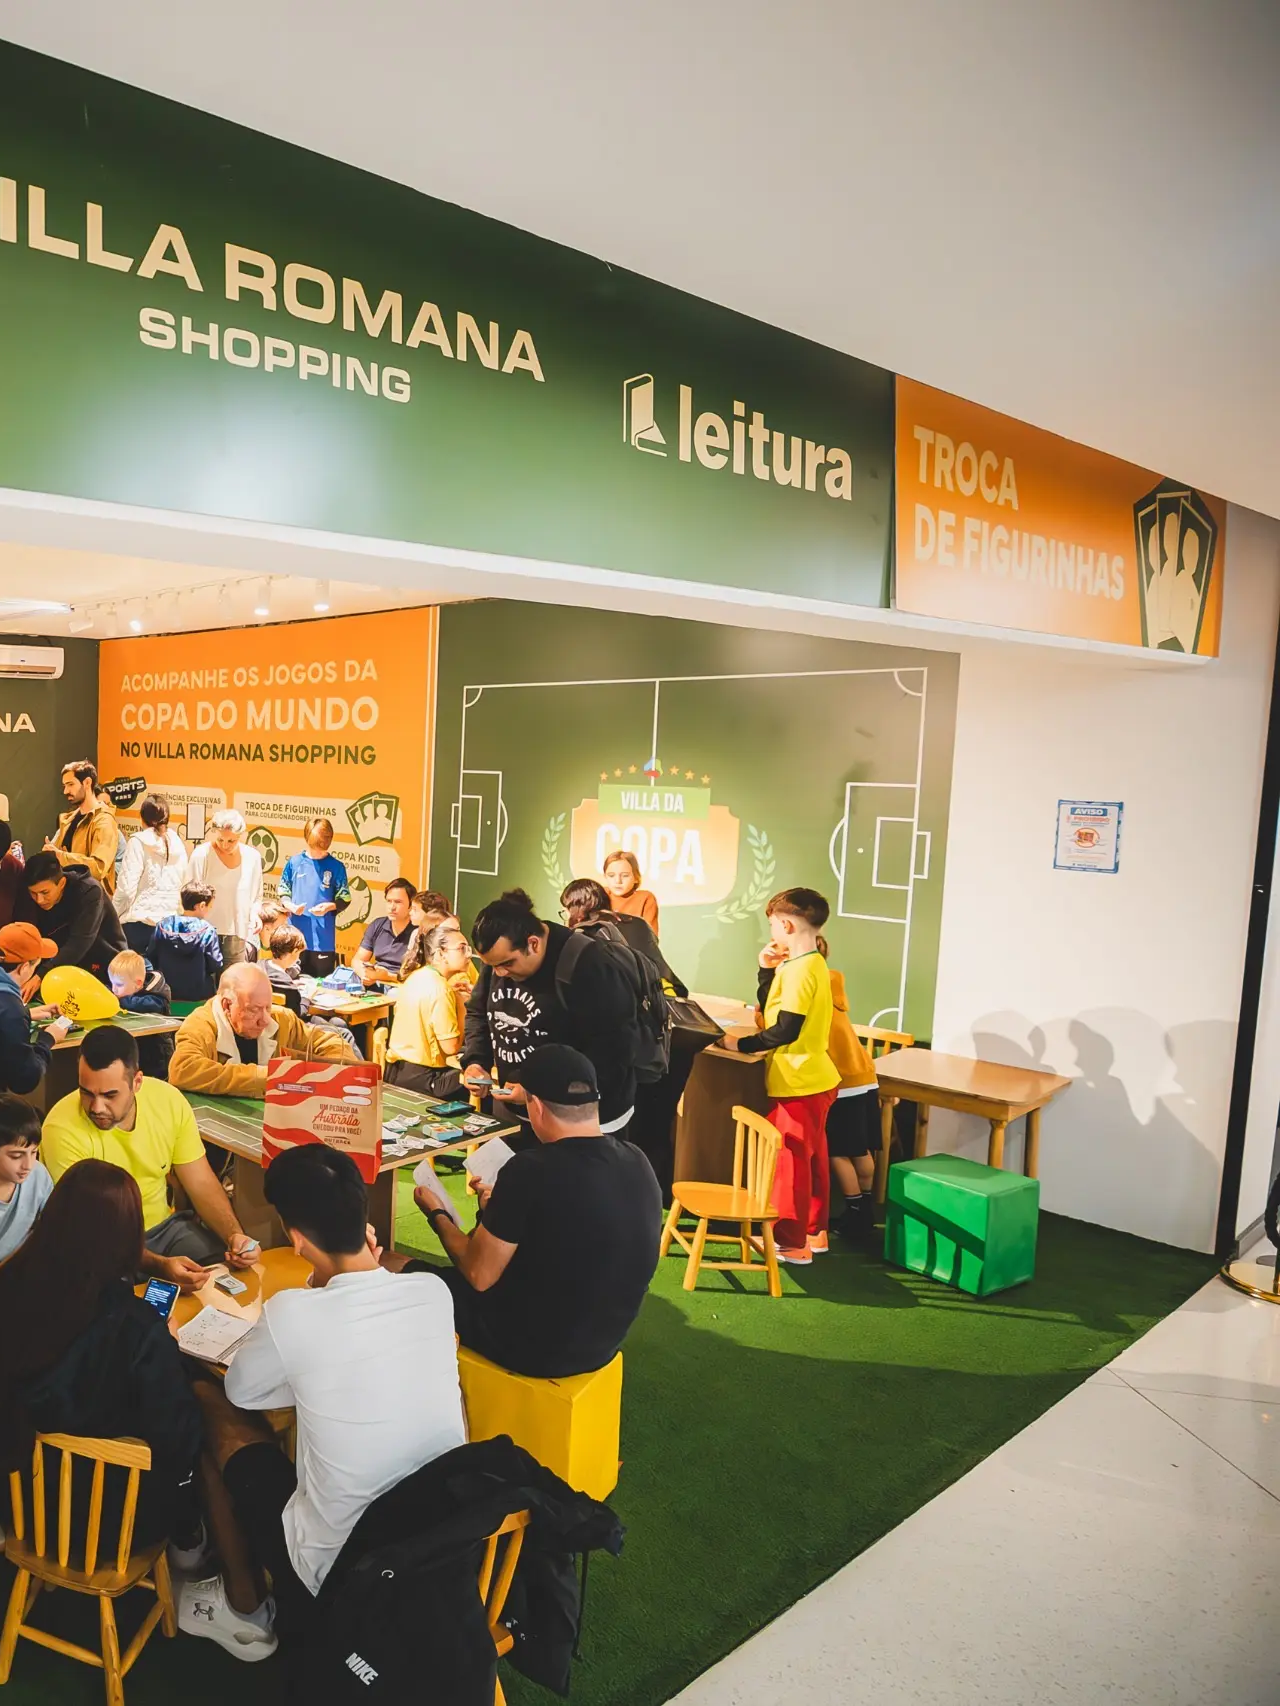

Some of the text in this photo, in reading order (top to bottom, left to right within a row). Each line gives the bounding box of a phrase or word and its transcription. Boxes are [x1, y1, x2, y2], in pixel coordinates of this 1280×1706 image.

[225, 242, 545, 382] ROMANA
[138, 307, 411, 403] SHOPPING
[678, 383, 853, 501] leitura
[913, 424, 1019, 511] TROCA
[914, 503, 1125, 601] DE FIGURINHAS
[120, 658, 378, 693] ACOMPANHE OS JOGOS DA
[120, 695, 379, 731] COPA DO MUNDO
[120, 741, 377, 766] NO VILLA ROMANA SHOPPING
[104, 780, 144, 793] PORTS
[186, 795, 221, 804] EXCLUSIVAS
[620, 791, 684, 813] VILLA DA
[245, 801, 337, 817] TROCA DE FIGURINHAS
[350, 863, 380, 873] INFANTIL
[358, 854, 381, 864] KIDS
[595, 822, 706, 886] COPA
[491, 987, 541, 1018] CATRAIAS
[345, 1652, 379, 1686] NIKE
